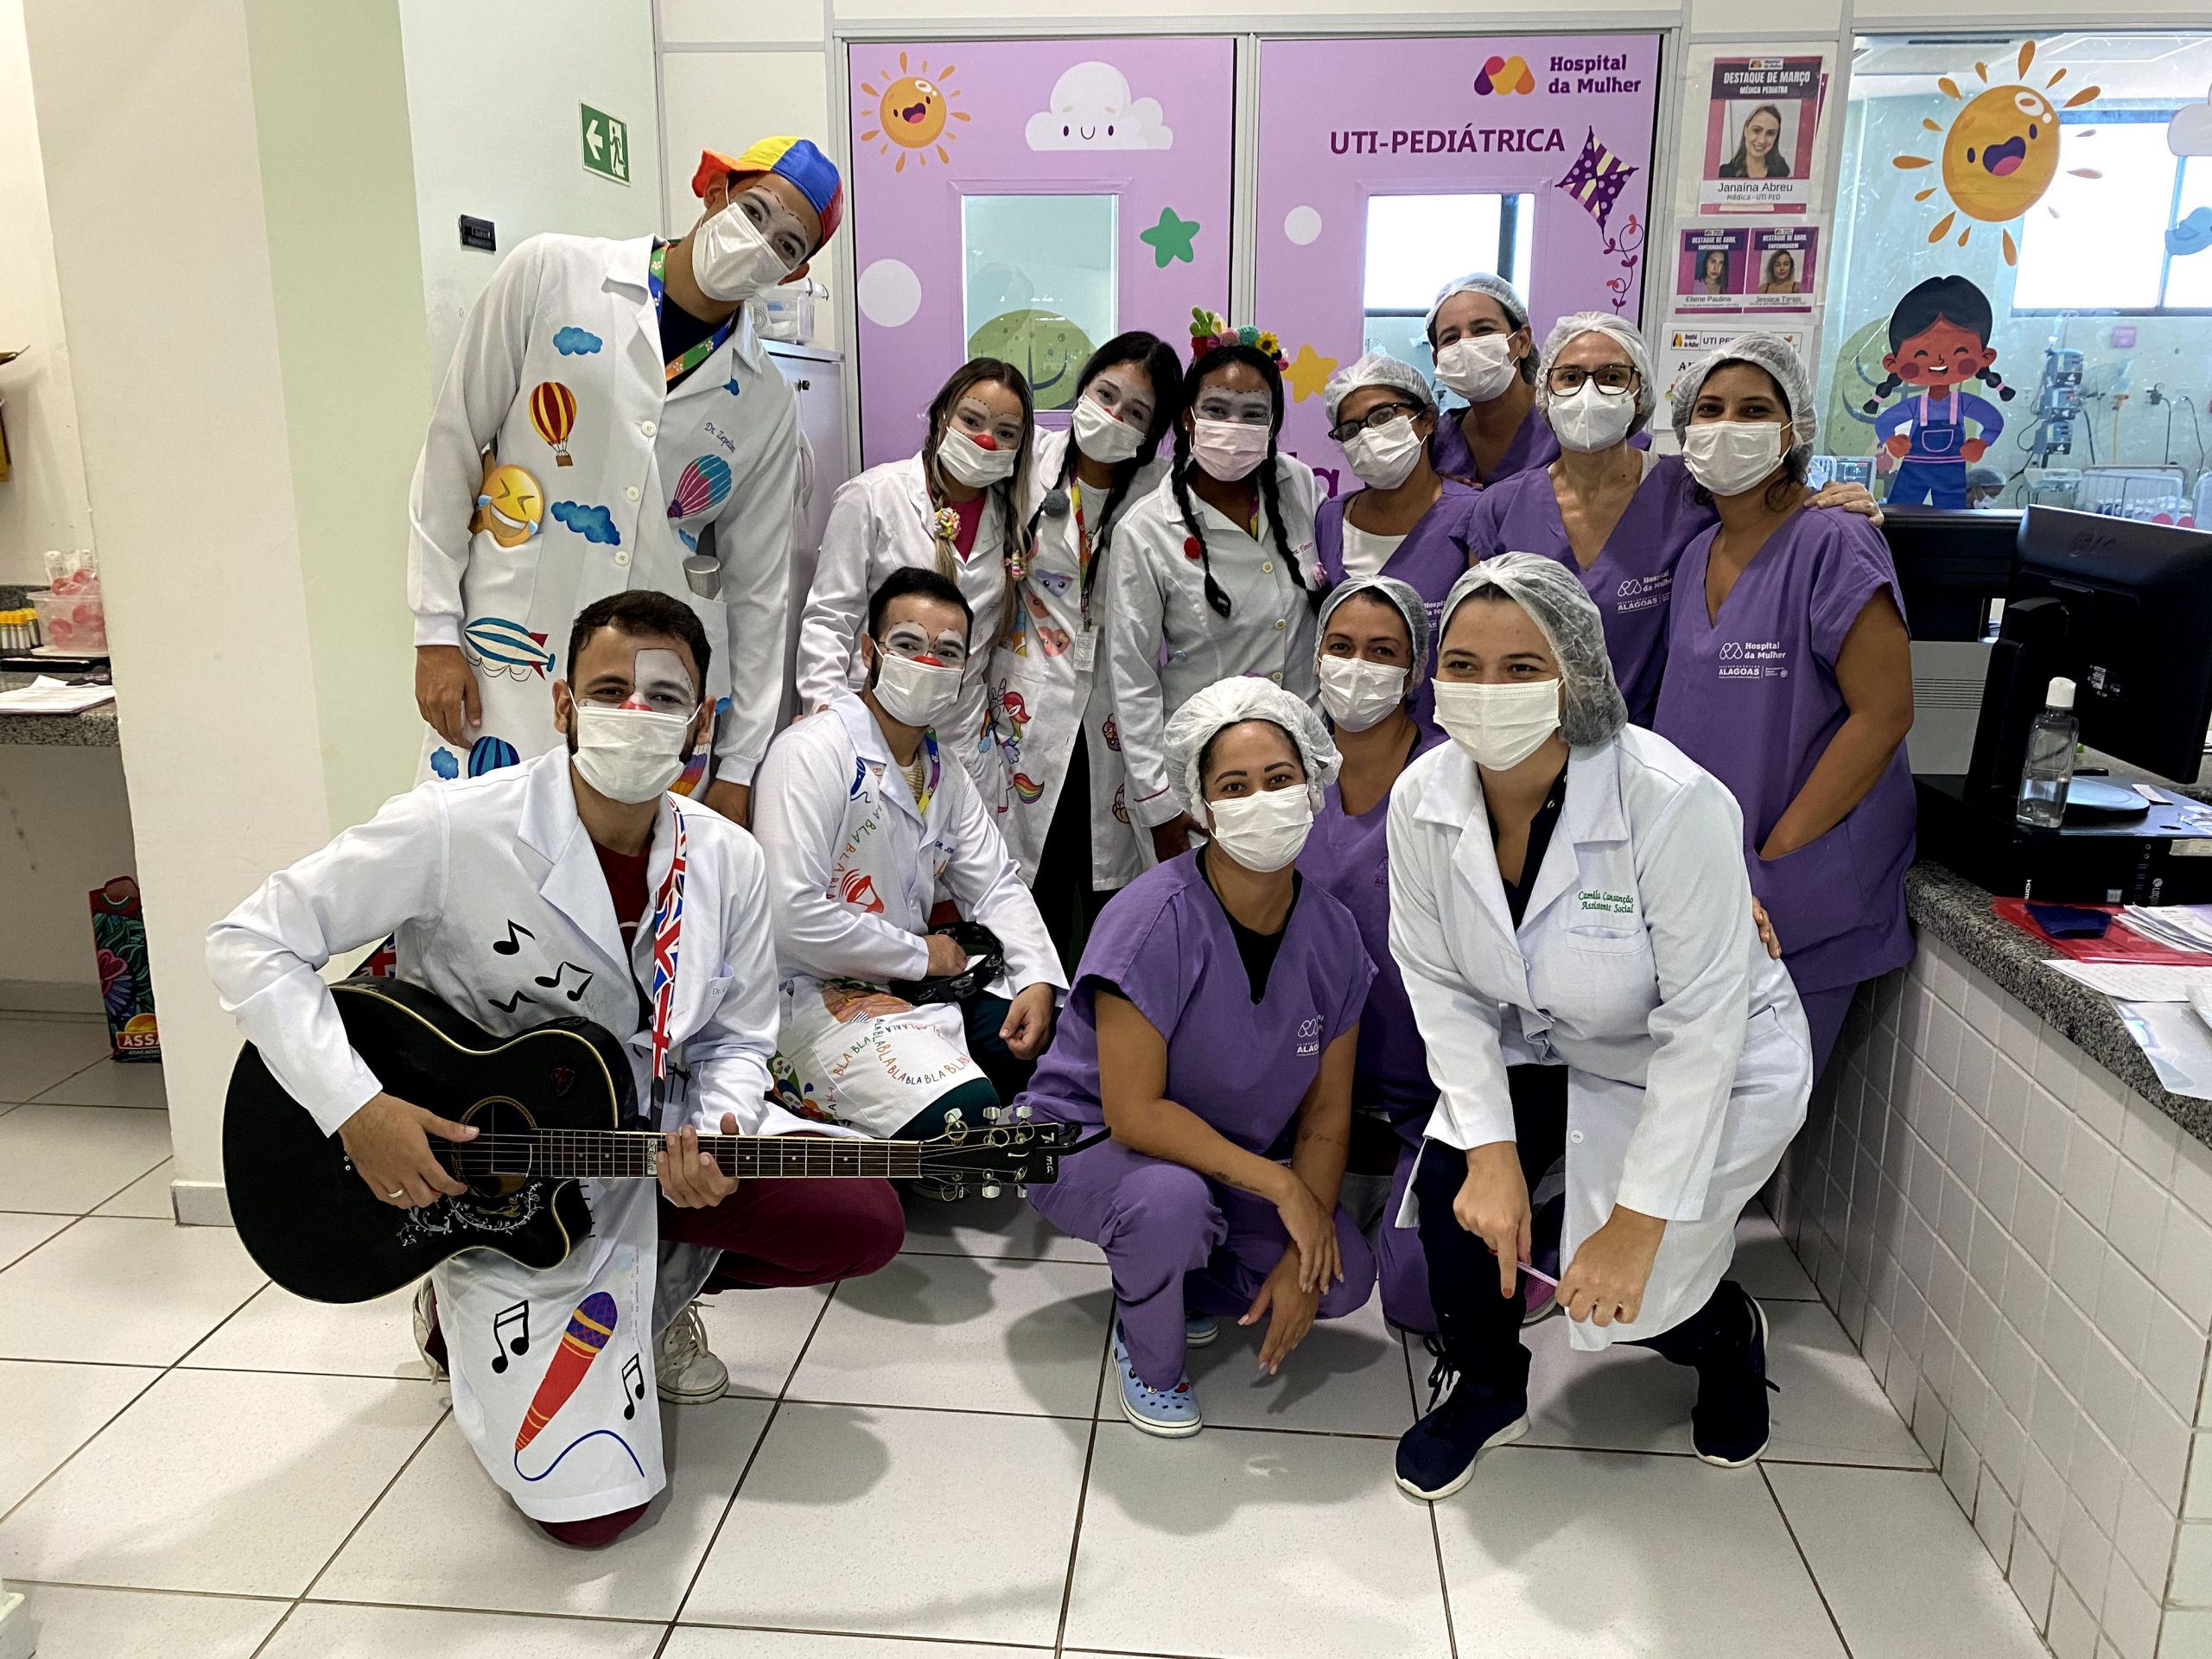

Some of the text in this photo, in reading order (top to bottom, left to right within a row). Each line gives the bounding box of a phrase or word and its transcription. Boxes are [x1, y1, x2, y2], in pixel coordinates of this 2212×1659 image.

[1549, 54, 1627, 74] Hospital
[1548, 77, 1641, 93] da Mulher
[1724, 71, 1810, 86] DESTAQUE DE MARÇO
[1739, 85, 1788, 94] MÉDICA PEDIATRA
[1331, 123, 1565, 154] UTI-PEDIÁTRICA
[1718, 182, 1793, 192] Janaína Abreu
[1618, 597, 1658, 611] ALAGOAS
[1745, 641, 1780, 651] Hospital
[1758, 651, 1786, 659] Mulher
[851, 818, 876, 843] BLA
[834, 842, 856, 872] BLA
[1578, 889, 1600, 900] Camila
[1581, 901, 1634, 913] Assistente Social
[124, 1034, 160, 1046] ASS
[1297, 1044, 1319, 1053] ALAG
[833, 1052, 852, 1077] BLA
[851, 1036, 871, 1054] BLA
[876, 1044, 897, 1067] BLA
[887, 1065, 907, 1082] BLA
[906, 1076, 922, 1084] BLA
[924, 1070, 946, 1084] BLA
